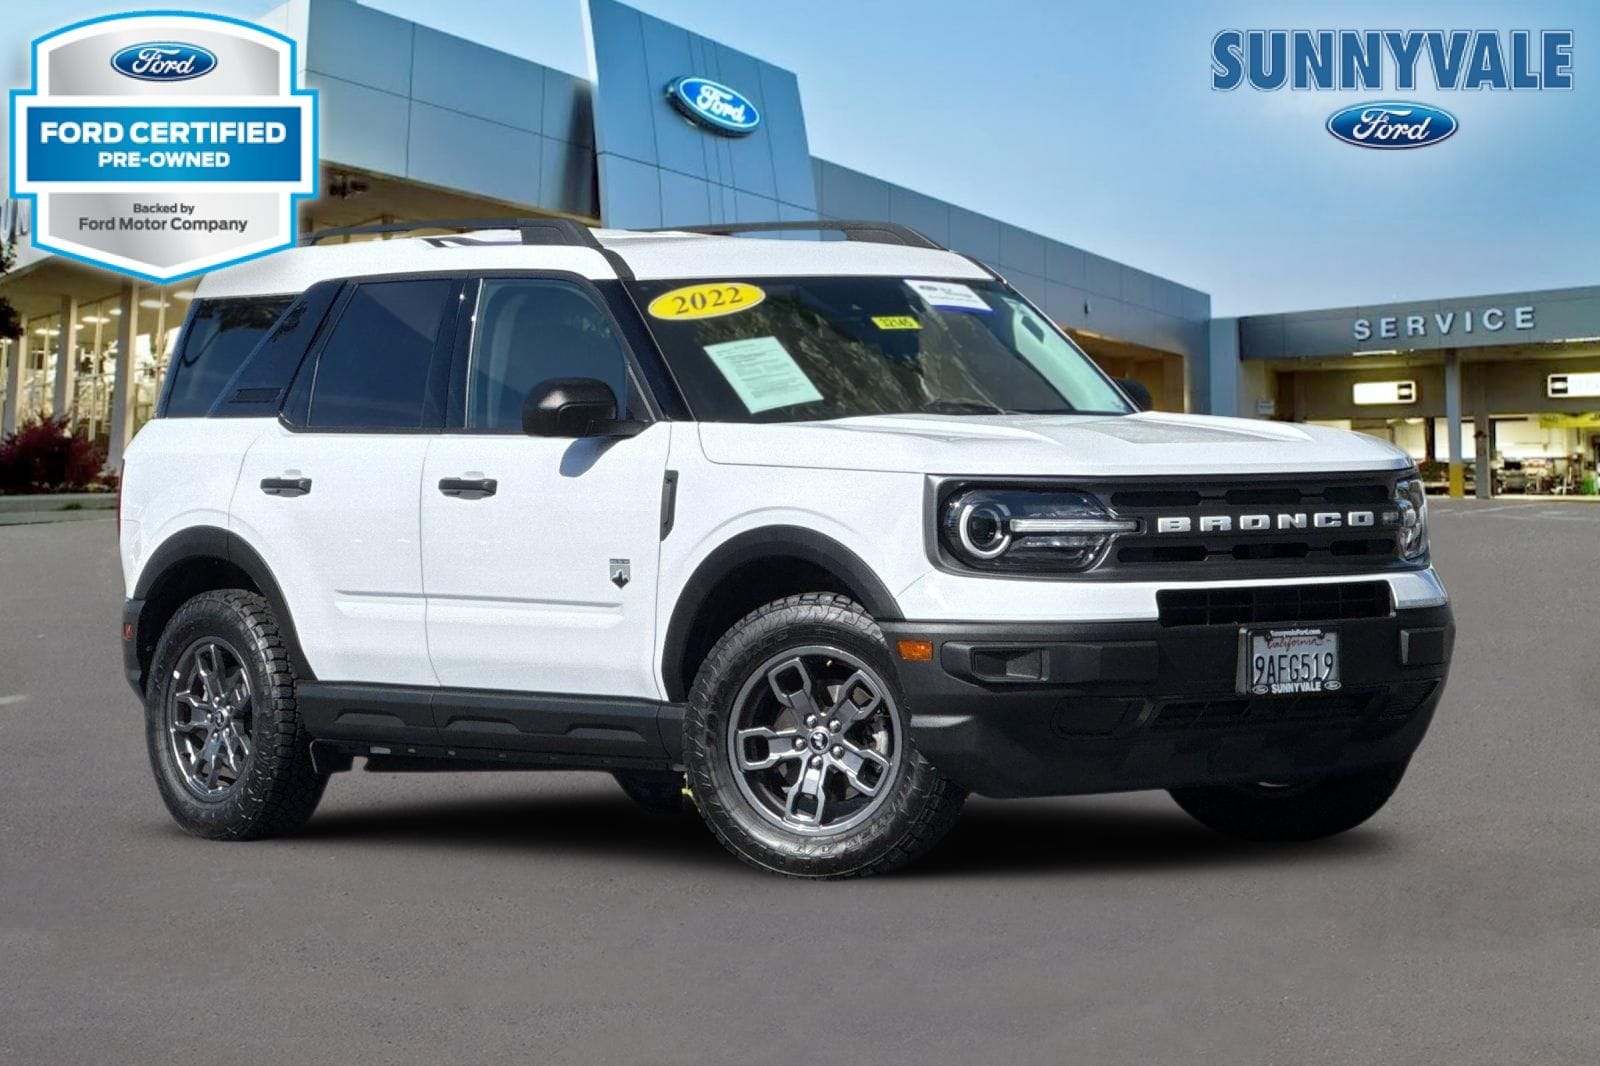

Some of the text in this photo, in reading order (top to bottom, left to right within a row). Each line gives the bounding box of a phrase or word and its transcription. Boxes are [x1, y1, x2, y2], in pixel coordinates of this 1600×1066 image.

[696, 84, 746, 123] Ford
[671, 286, 744, 315] 2022
[1353, 305, 1536, 341] SERVICE
[1157, 511, 1375, 533] BRONCO
[1254, 652, 1334, 685] 9AFG519
